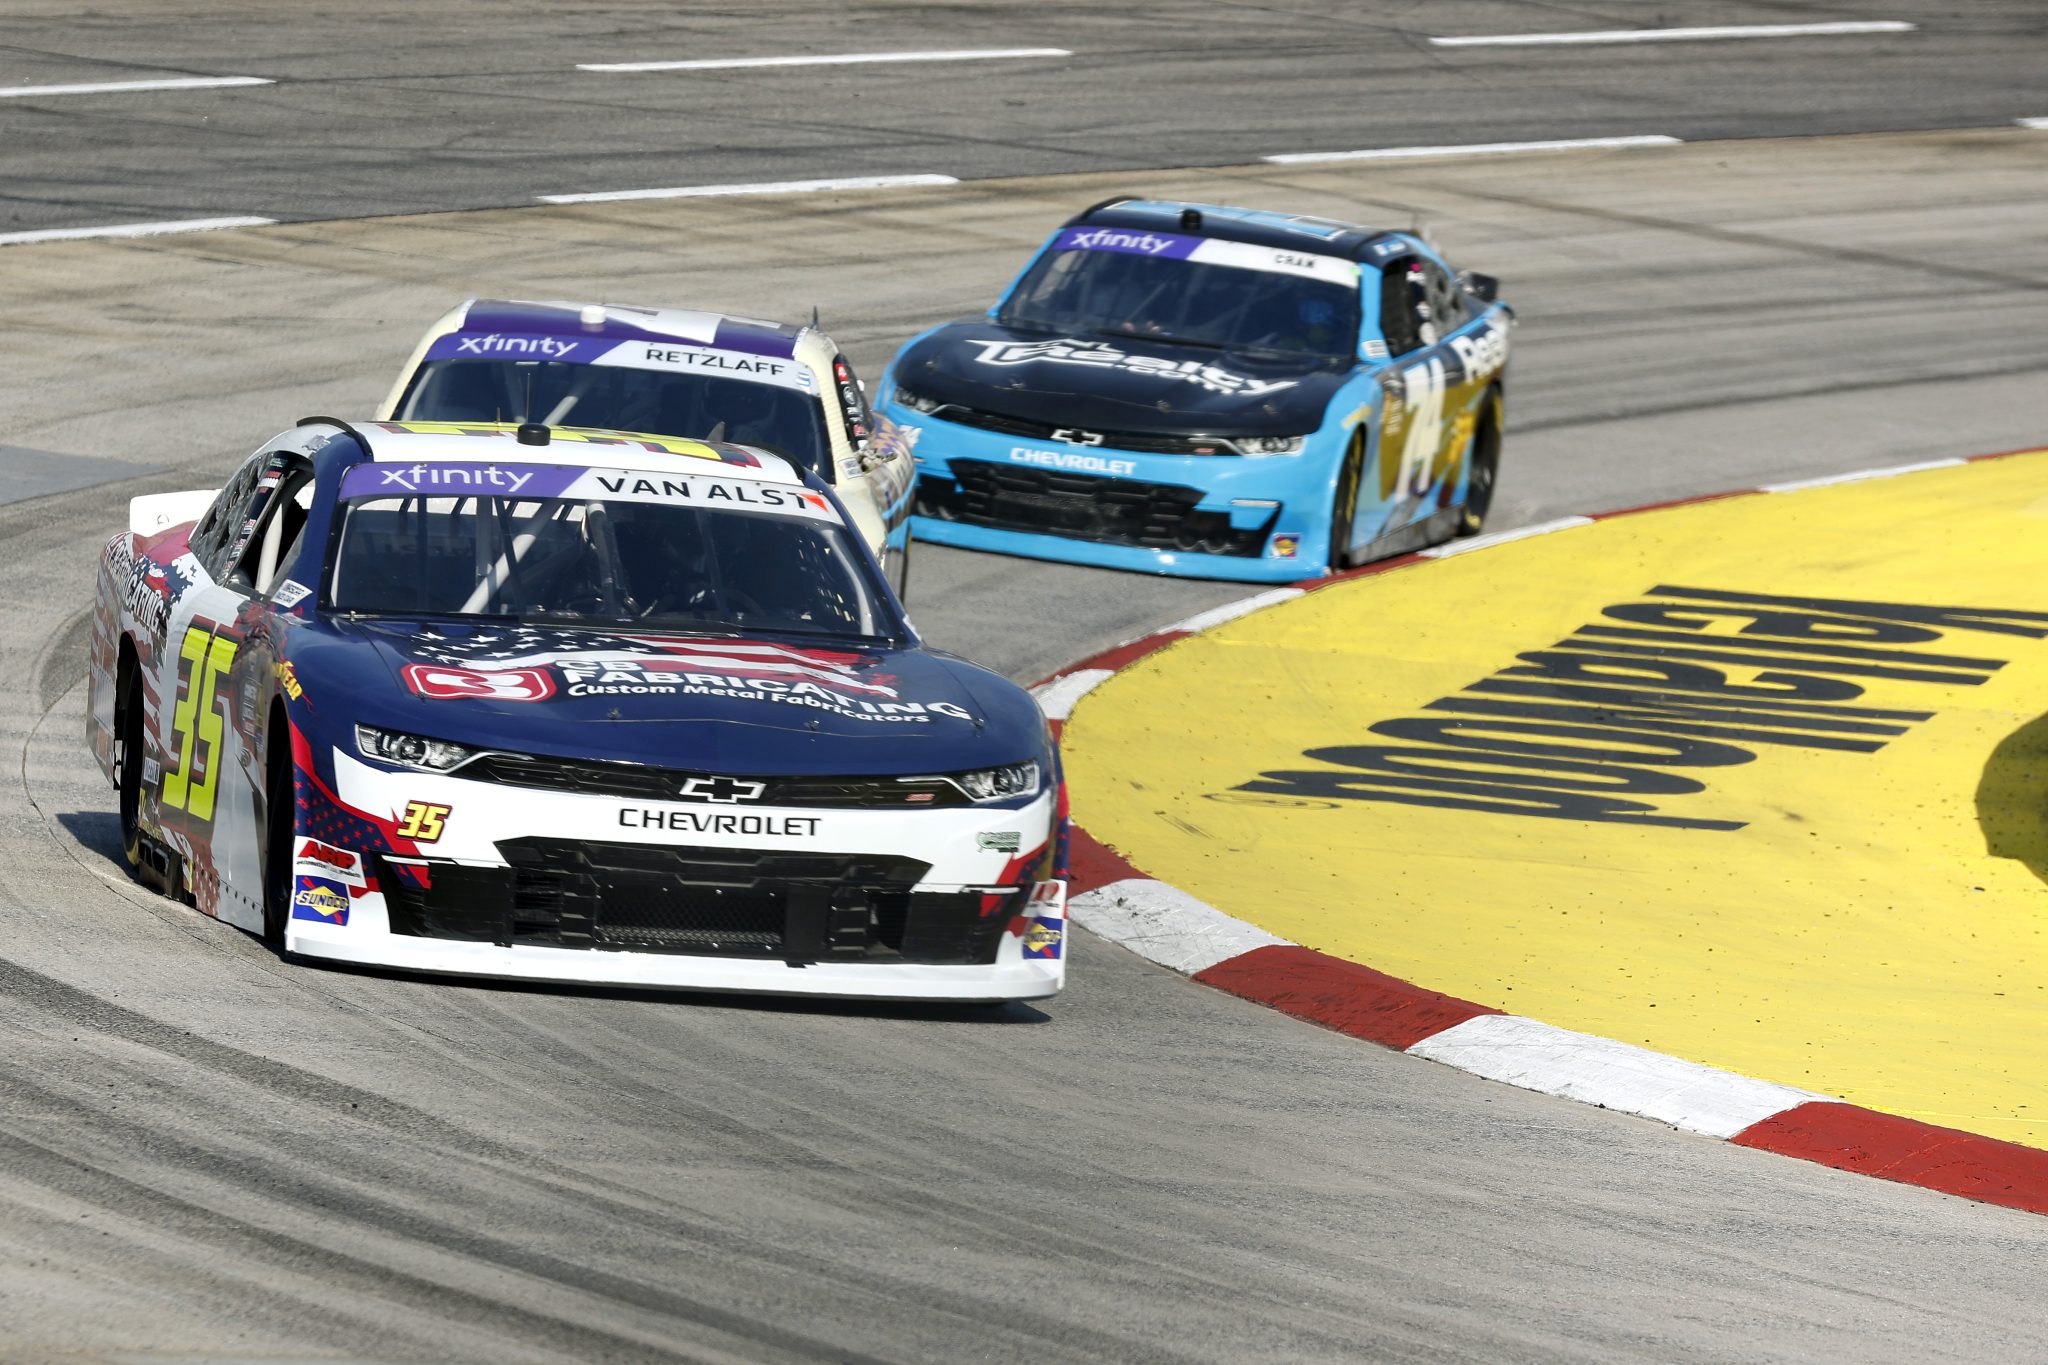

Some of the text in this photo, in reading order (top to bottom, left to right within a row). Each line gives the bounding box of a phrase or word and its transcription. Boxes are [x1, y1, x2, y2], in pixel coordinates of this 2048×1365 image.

[1069, 229, 1174, 254] xfinity
[456, 334, 579, 357] xfinity
[645, 348, 785, 376] RETZLAFF
[1395, 357, 1446, 502] 74
[1010, 447, 1136, 475] CHEVROLET
[380, 464, 533, 491] xfinity
[597, 476, 690, 498] VAN
[554, 660, 640, 671] CB
[563, 669, 971, 720] FABRICATING
[568, 683, 930, 723] Custom Metal Fabricators
[162, 627, 239, 822] 35
[397, 800, 451, 842] 35
[619, 809, 822, 836] CHEVROLET
[298, 840, 356, 869] ARP
[299, 892, 348, 909] SUNOCO
